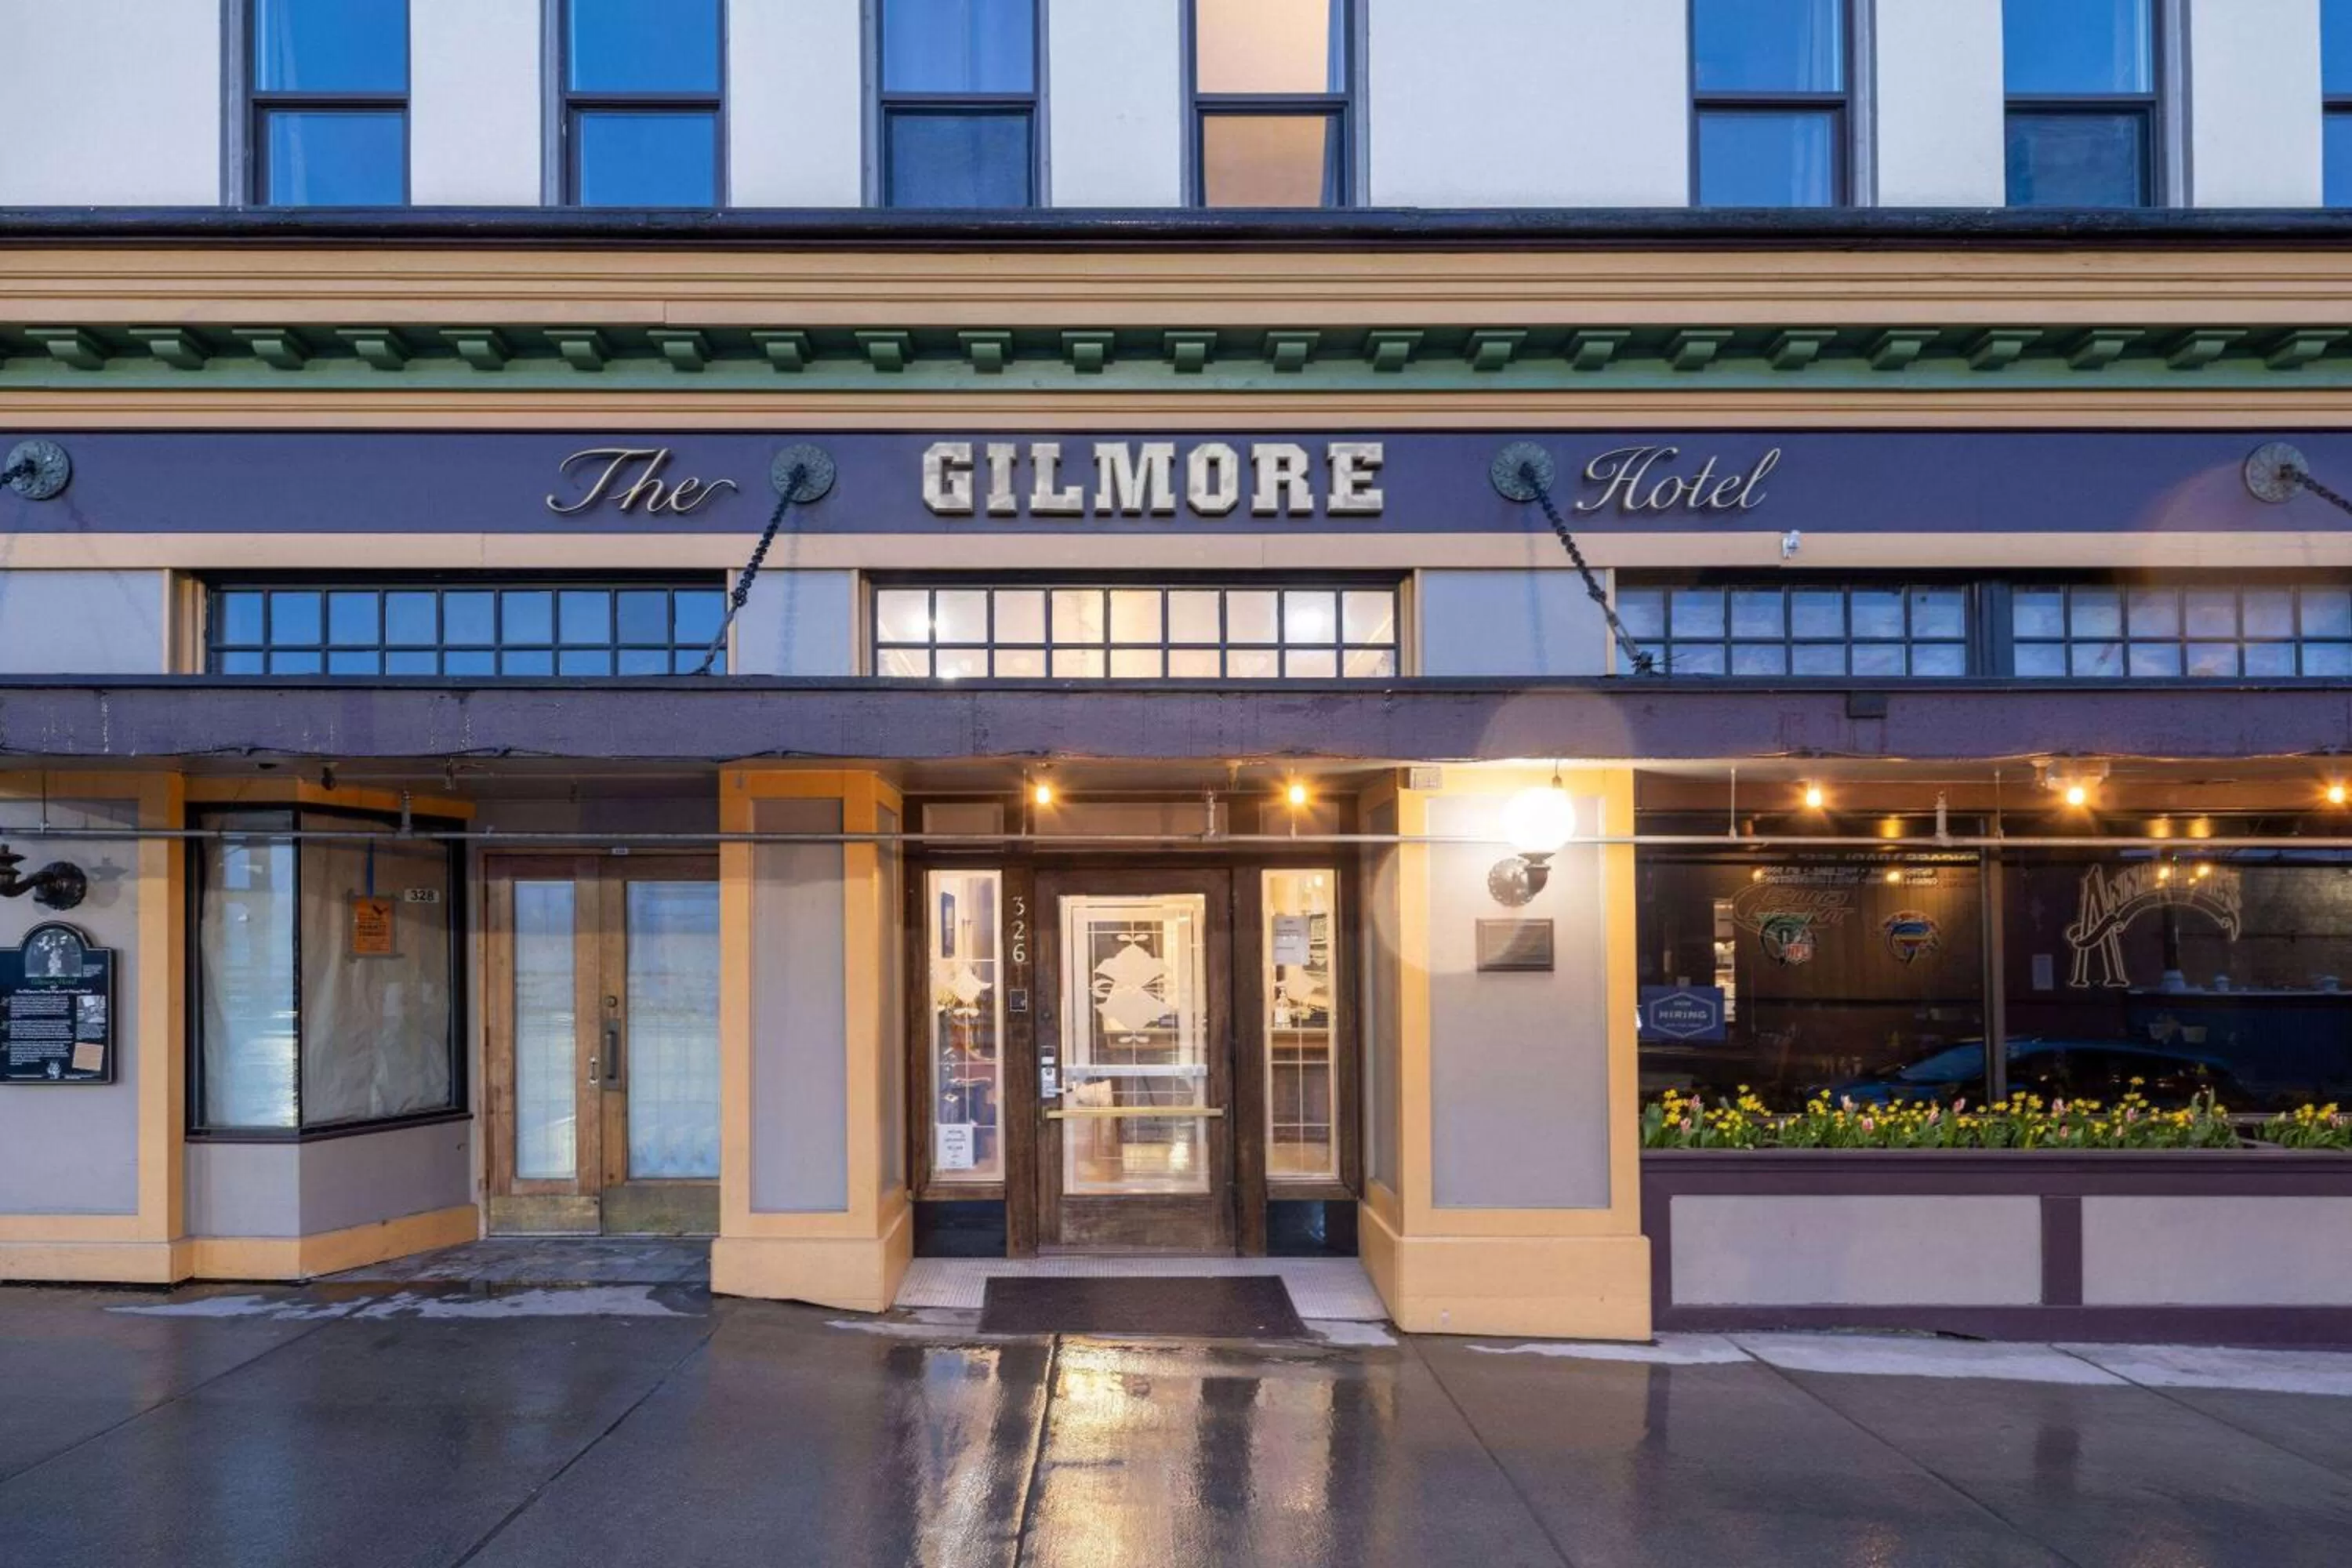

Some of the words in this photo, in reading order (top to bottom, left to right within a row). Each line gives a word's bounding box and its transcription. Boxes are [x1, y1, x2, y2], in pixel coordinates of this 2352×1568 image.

[546, 448, 738, 512] The
[923, 441, 1384, 516] GILMORE
[1576, 447, 1780, 510] Hotel
[1012, 896, 1026, 962] 326
[1658, 1010, 1707, 1019] HIRING
